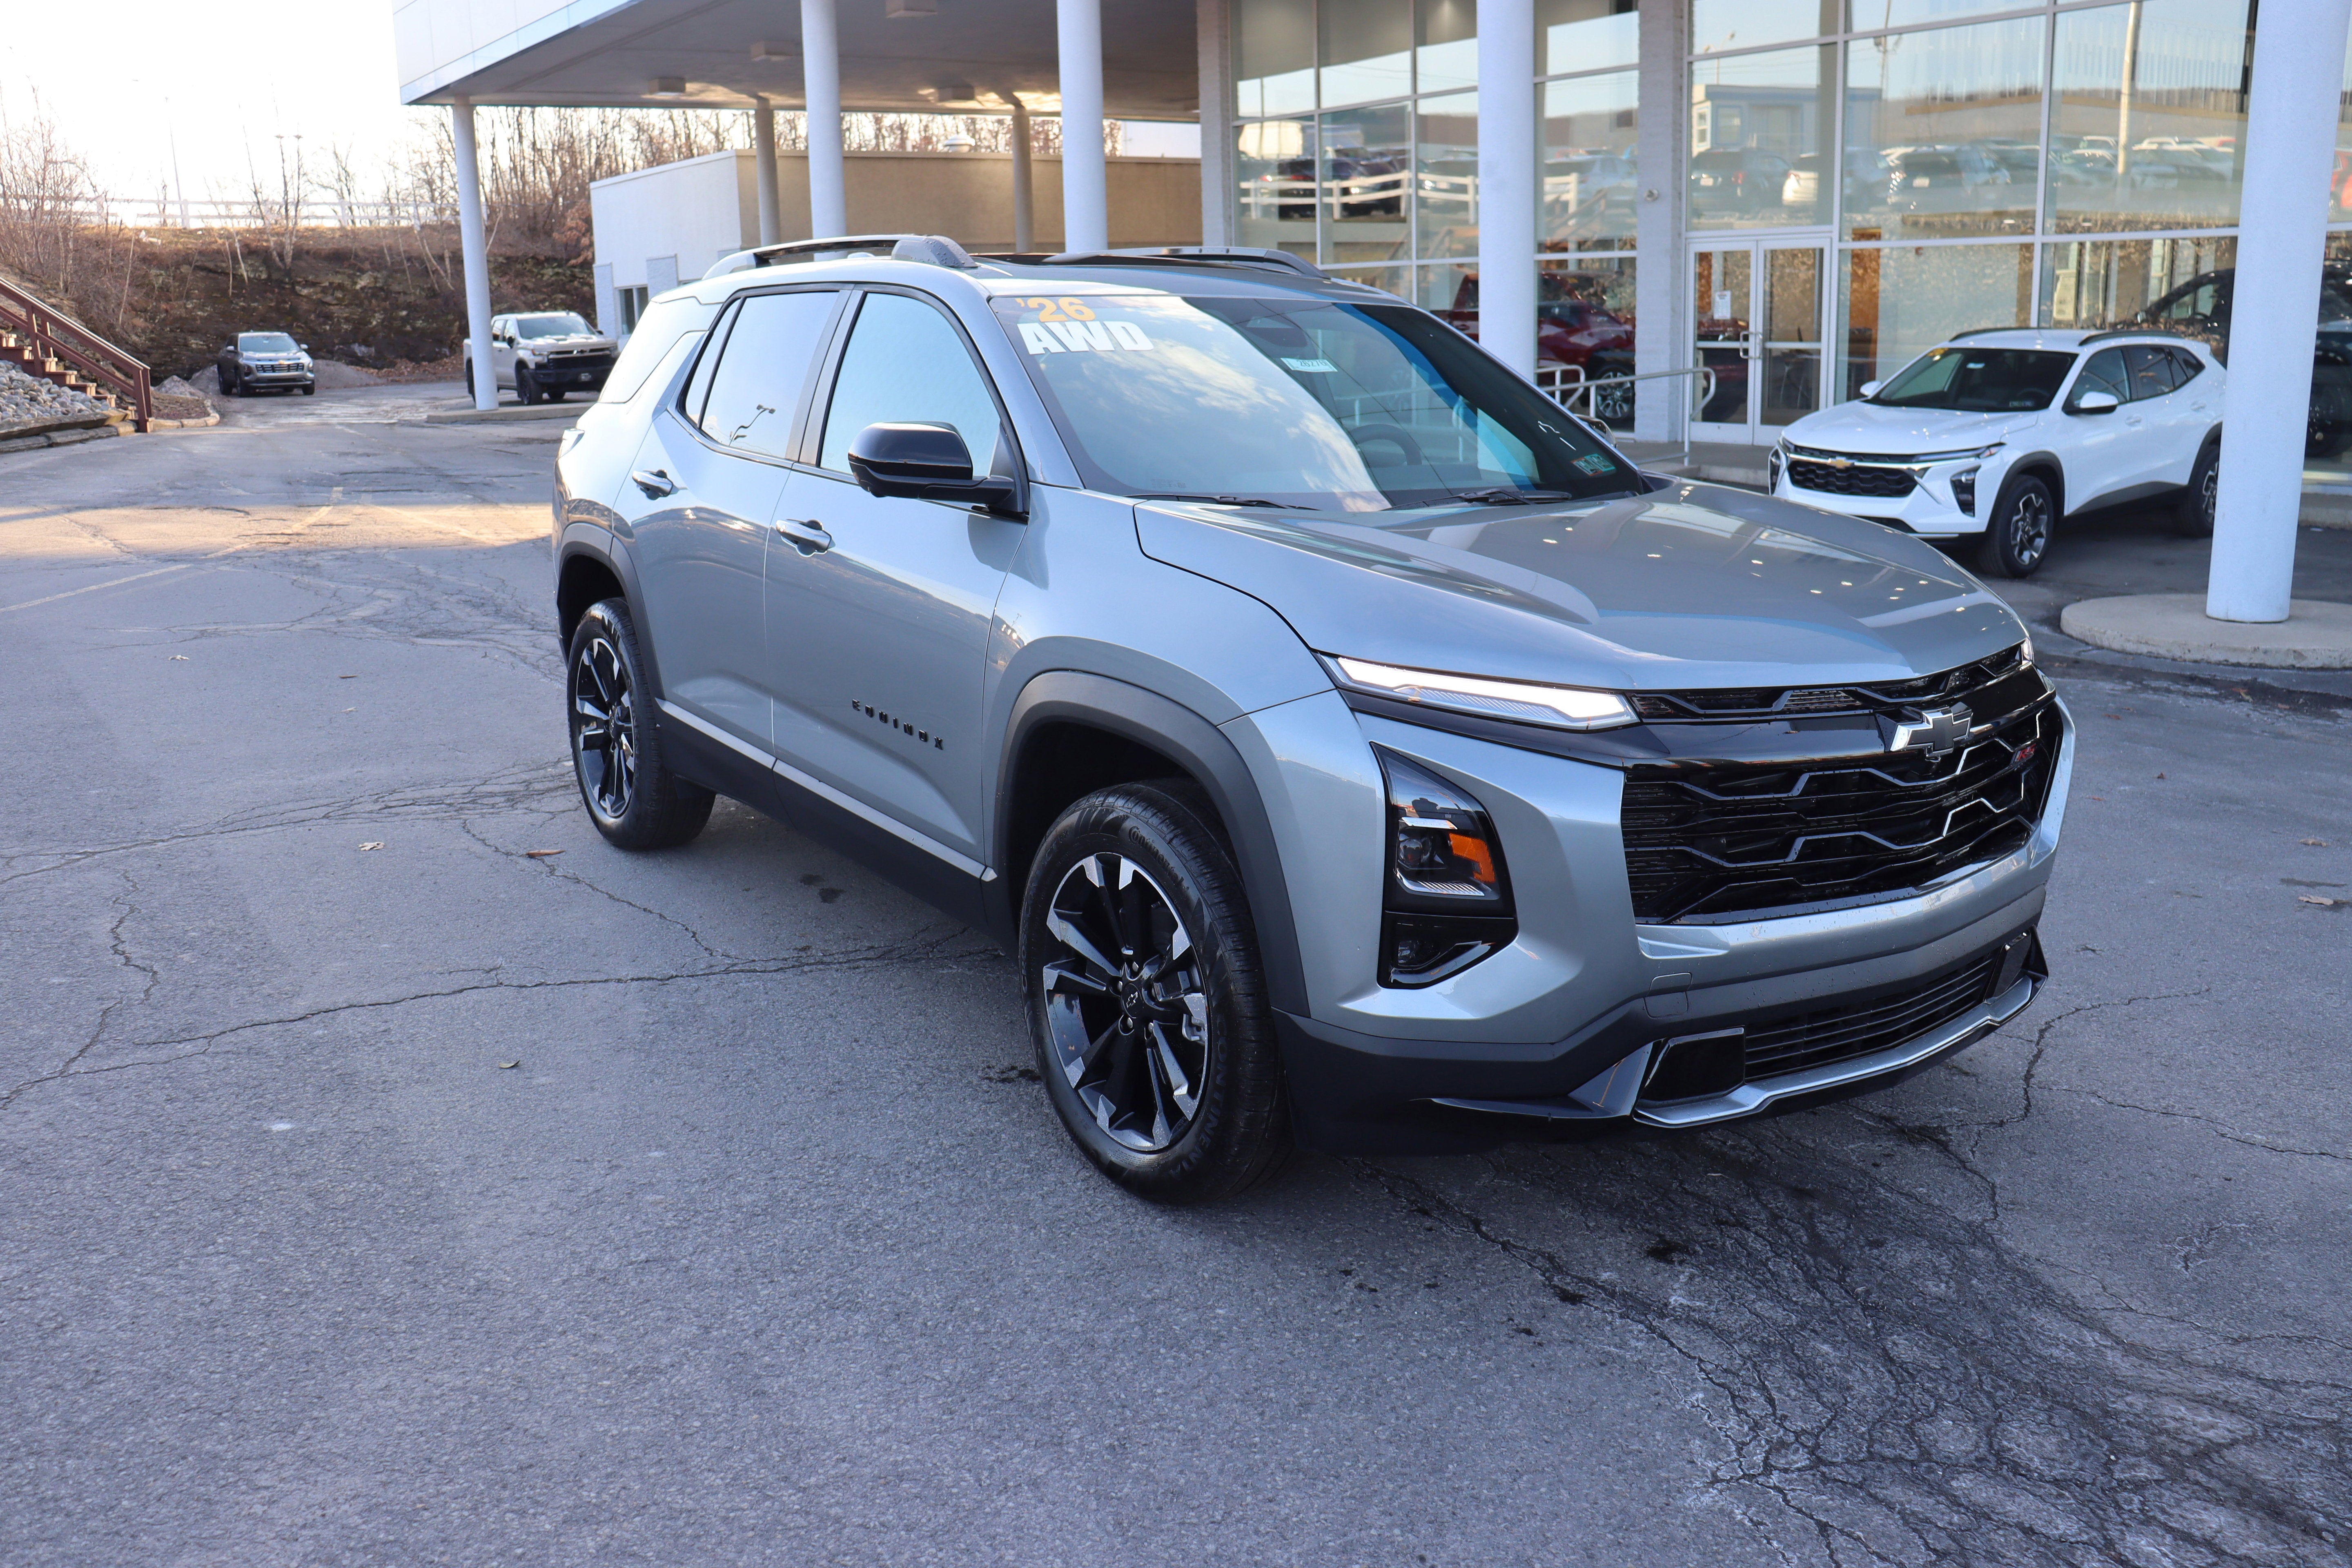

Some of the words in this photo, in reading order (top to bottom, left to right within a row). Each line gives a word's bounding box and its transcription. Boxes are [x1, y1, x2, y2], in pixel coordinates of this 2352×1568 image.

[1016, 297, 1096, 322] '26
[1017, 321, 1154, 355] AWD
[852, 699, 944, 751] EQUINOX
[2017, 744, 2036, 762] RS
[1128, 826, 1185, 884] Continental
[1021, 841, 1058, 993] CROSSCONCT
[1166, 1019, 1226, 1181] CONTINENTA
